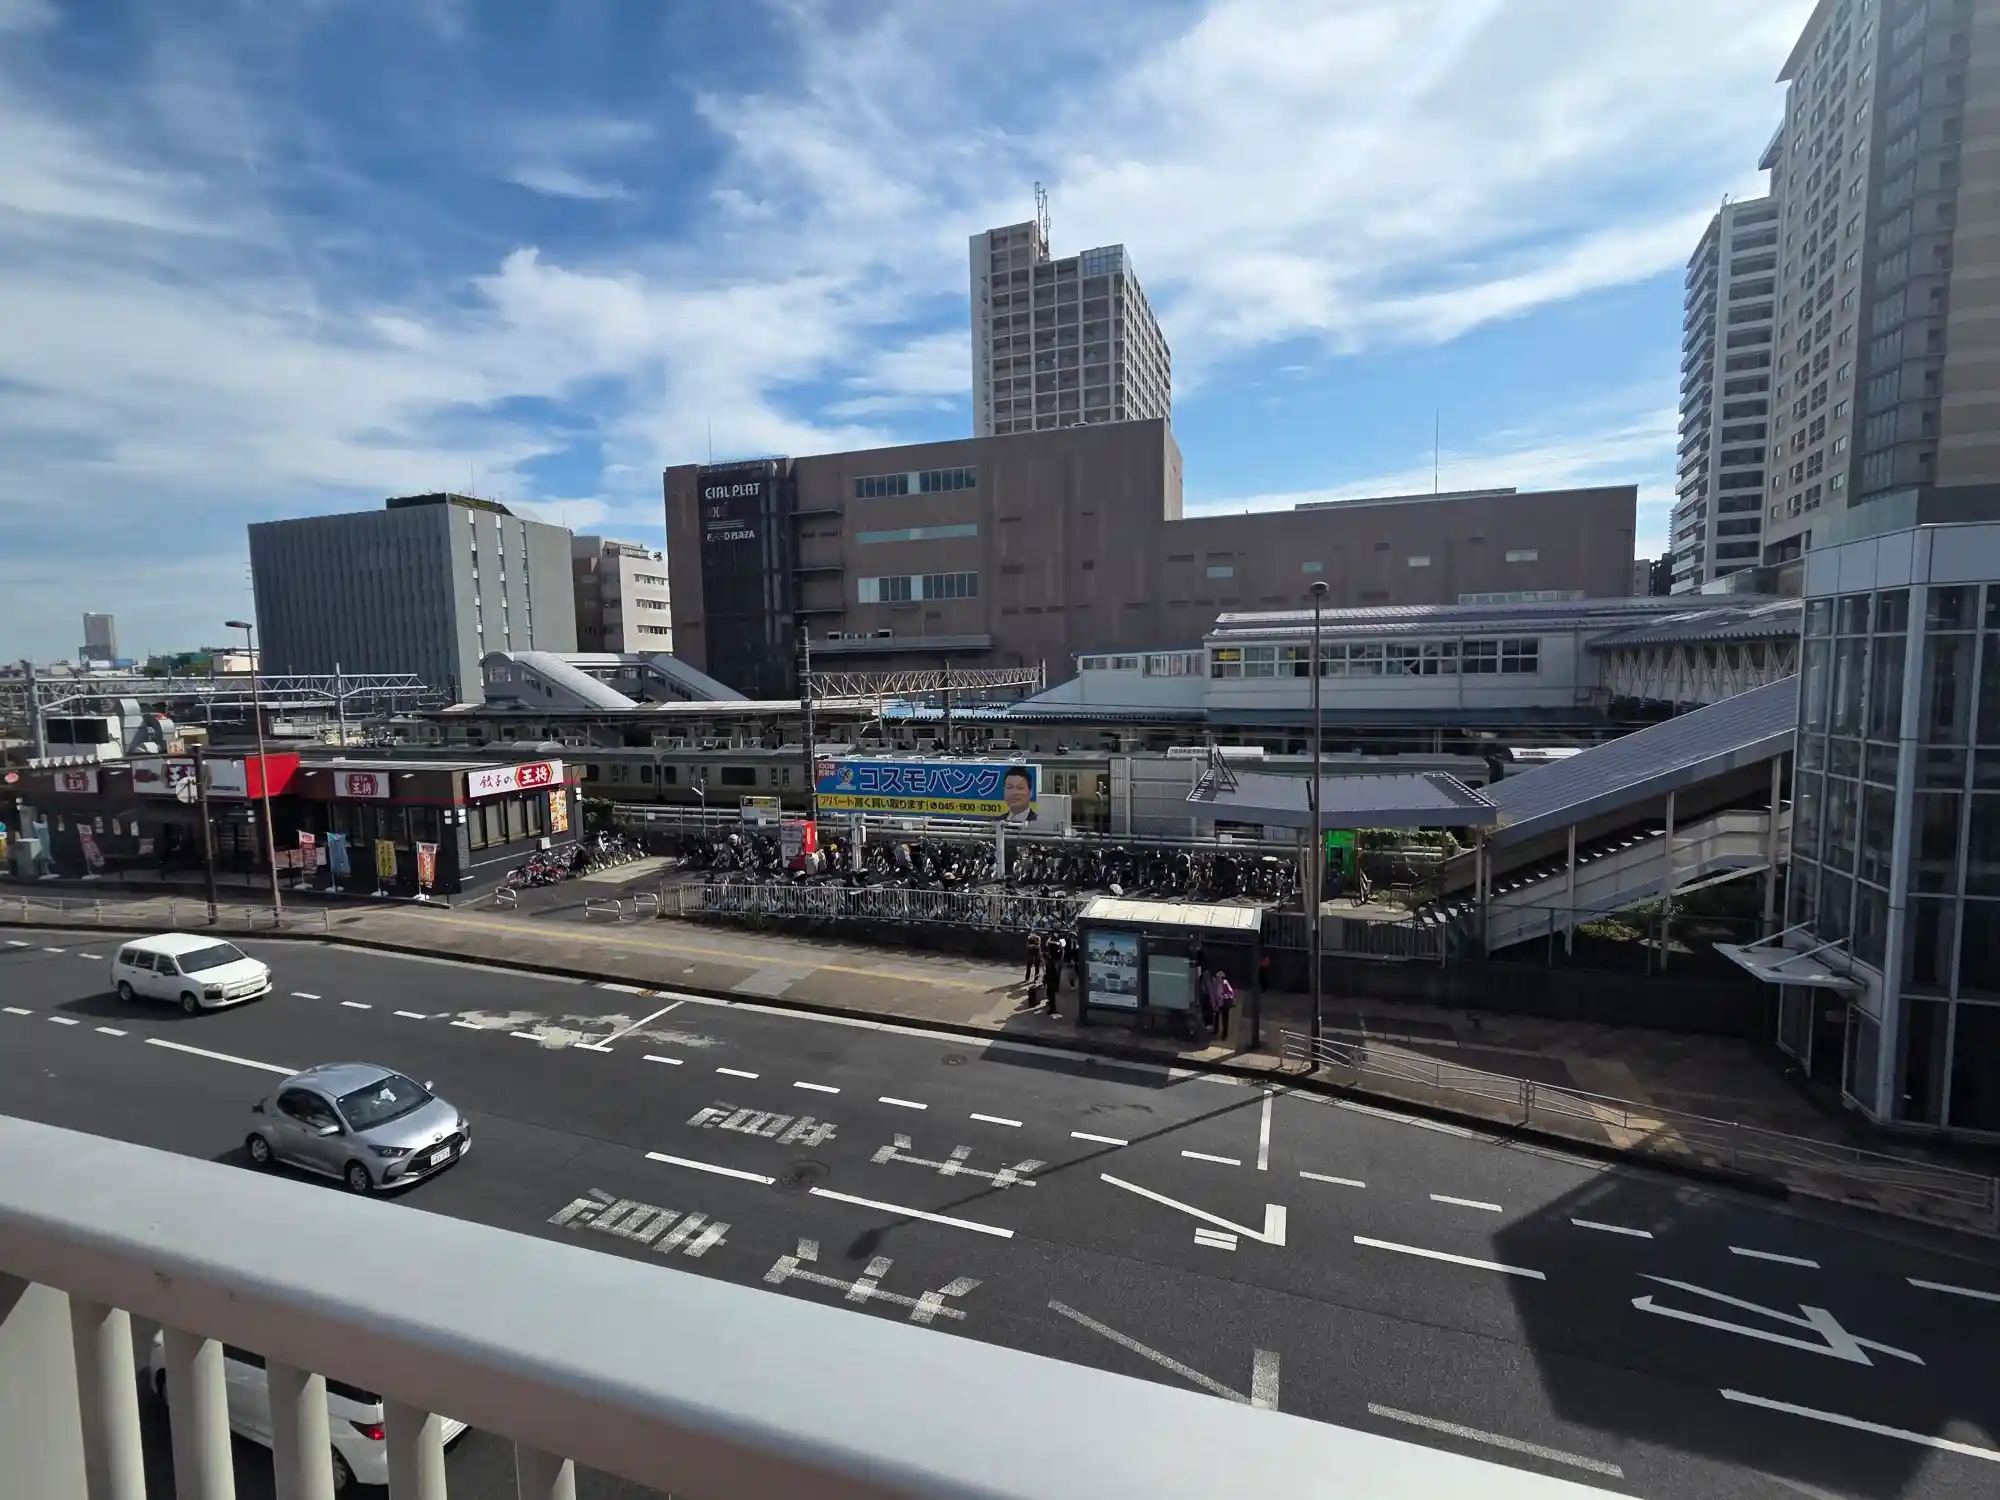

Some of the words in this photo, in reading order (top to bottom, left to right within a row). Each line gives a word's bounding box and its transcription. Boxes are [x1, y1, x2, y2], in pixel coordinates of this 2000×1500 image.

[732, 483, 760, 497] PLAT
[731, 530, 755, 540] PLAZA
[859, 767, 1001, 797] コスモバンク
